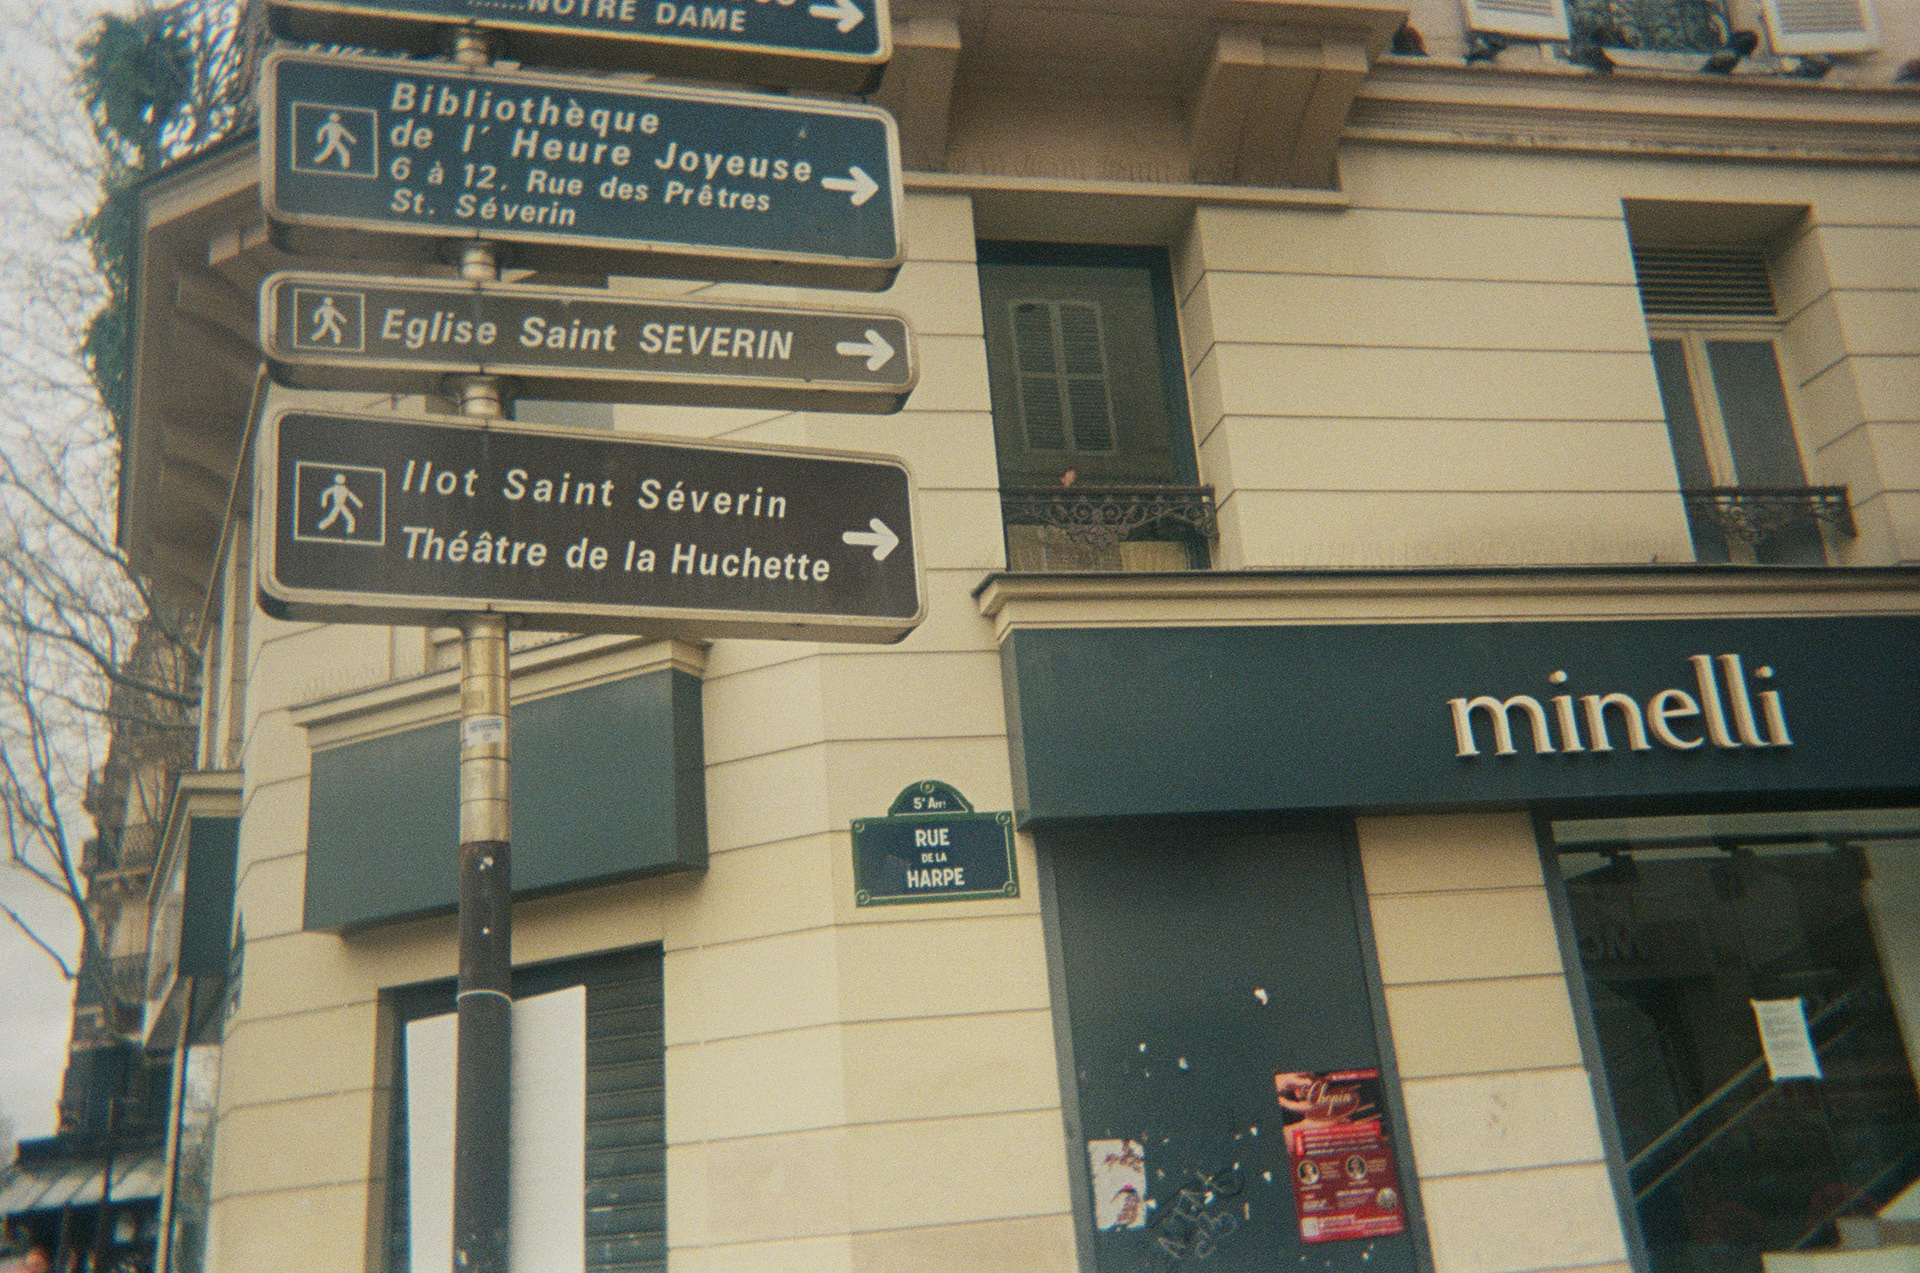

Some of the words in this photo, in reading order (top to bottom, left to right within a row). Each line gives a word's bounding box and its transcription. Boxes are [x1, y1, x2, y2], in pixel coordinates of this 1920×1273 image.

[656, 2, 747, 32] DAME
[391, 83, 660, 137] Bibliothèque
[390, 120, 433, 150] de
[512, 130, 632, 166] Heure
[655, 141, 813, 183] Joyeuse
[390, 158, 411, 182] 6
[427, 161, 445, 186] à
[527, 169, 584, 196] Rue
[600, 173, 649, 201] des
[664, 180, 771, 212] Prêtres
[390, 189, 436, 215] St.
[456, 193, 577, 227] Séverin
[381, 308, 498, 348] Eglise
[520, 317, 617, 352] Saint
[640, 323, 794, 360] SEVERIN
[503, 469, 615, 507] Saint
[638, 478, 788, 518] Séverin
[403, 526, 548, 566] Théâtre
[566, 536, 610, 570] de
[625, 541, 656, 573] la
[671, 543, 831, 582] Huchette
[1447, 653, 1793, 757] minelli
[914, 828, 950, 847] RUE
[921, 853, 934, 863] DE
[935, 853, 947, 862] LA
[907, 868, 965, 888] HARPE
